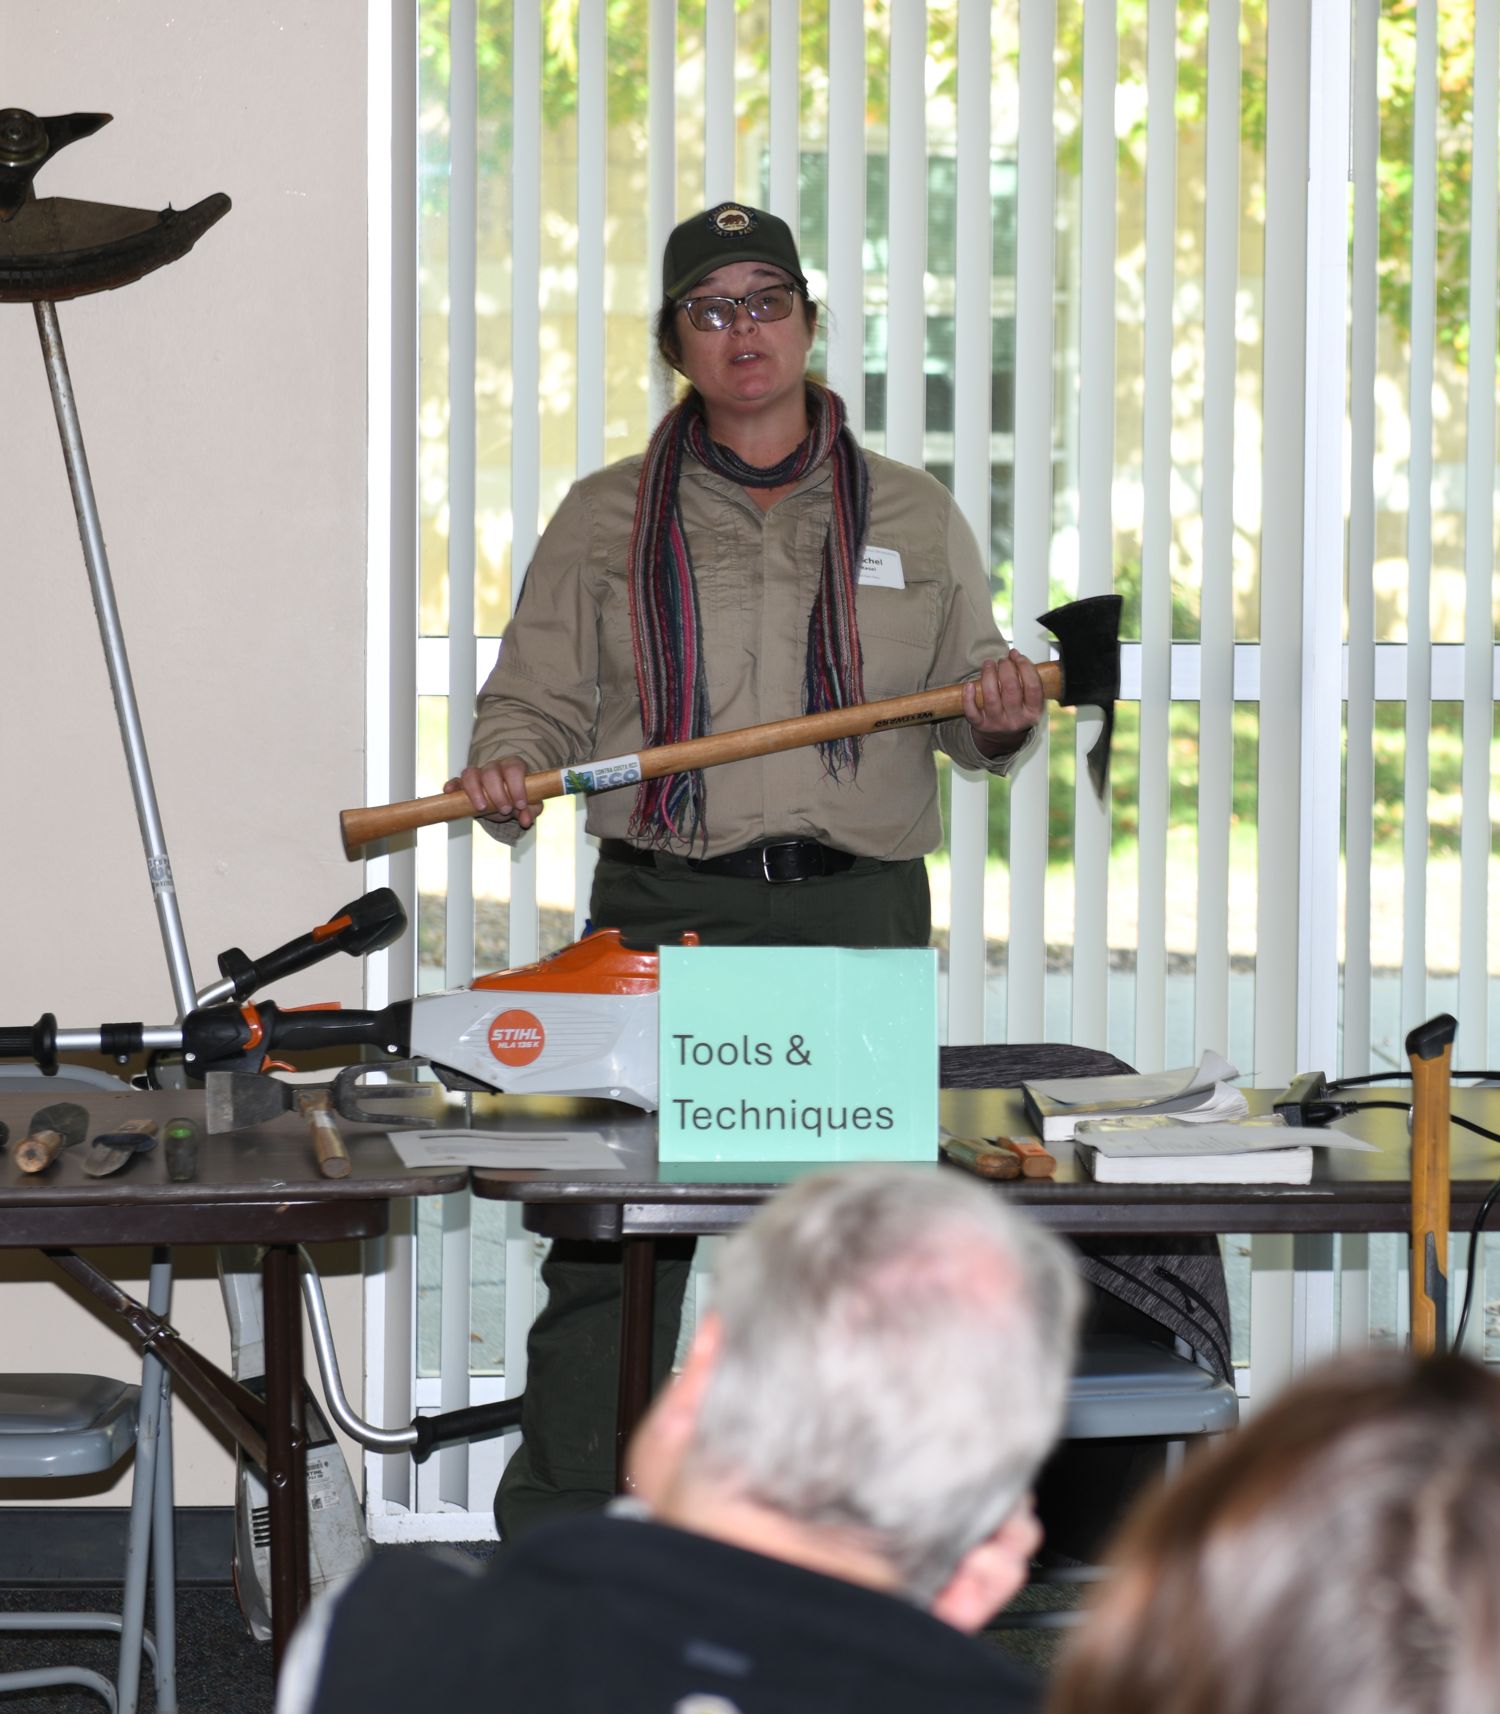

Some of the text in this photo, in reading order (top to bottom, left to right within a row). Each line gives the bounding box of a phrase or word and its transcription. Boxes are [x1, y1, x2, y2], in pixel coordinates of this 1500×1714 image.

[863, 557, 883, 566] chel
[874, 711, 934, 728] WESTWARD
[596, 769, 640, 787] ECO
[491, 1028, 542, 1041] STIHL
[672, 1034, 812, 1066] Tools &
[672, 1098, 895, 1138] Techniques
